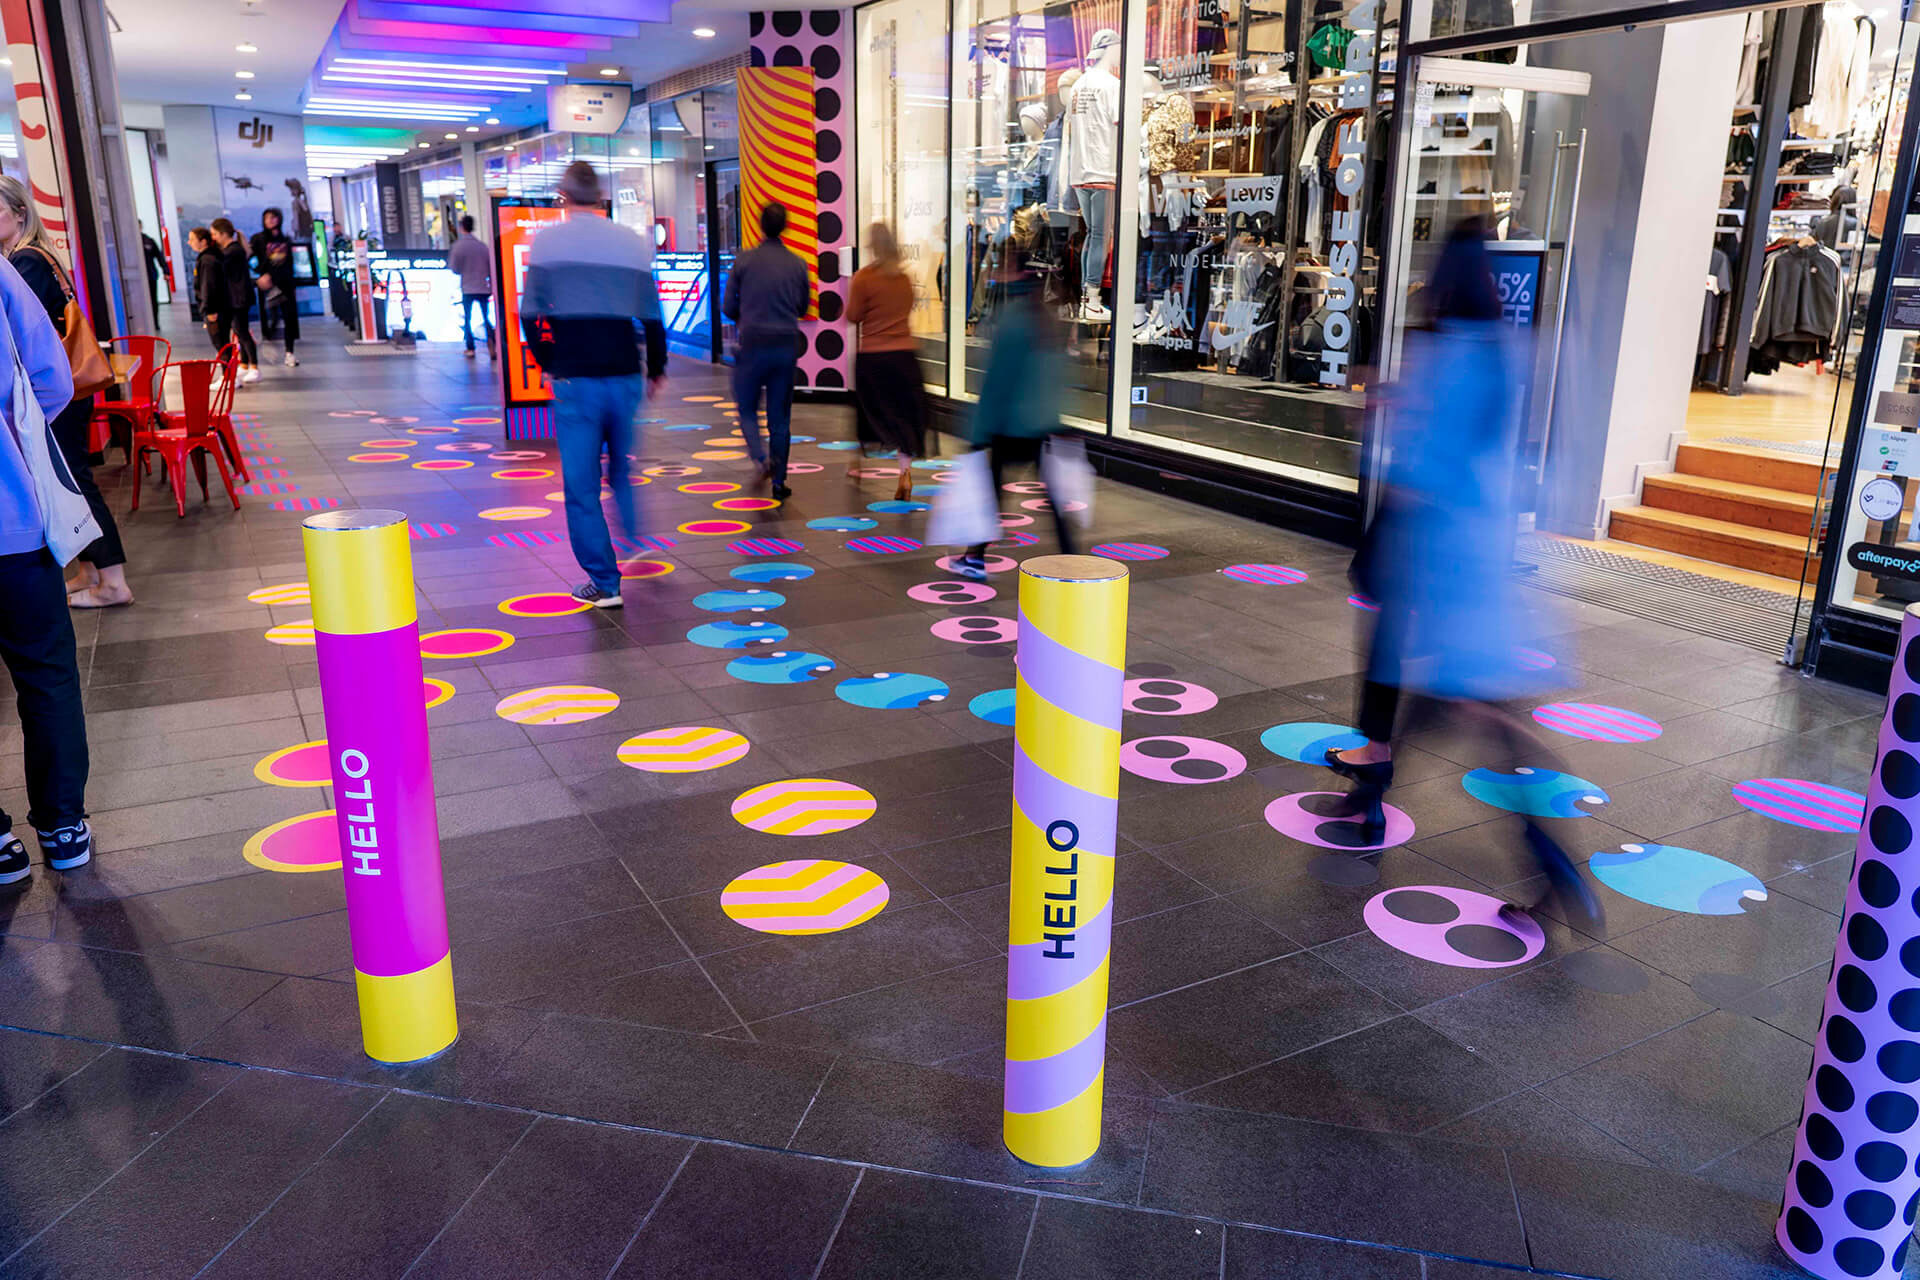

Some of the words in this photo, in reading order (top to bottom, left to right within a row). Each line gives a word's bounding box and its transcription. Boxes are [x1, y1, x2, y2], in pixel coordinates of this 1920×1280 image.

[1182, 0, 1229, 21] ARTICL
[1156, 50, 1213, 80] TOMMY
[1180, 73, 1212, 89] JEANS
[1336, 124, 1367, 197] OF
[1320, 210, 1360, 386] HOUSE
[1857, 550, 1909, 571] afterpay
[341, 749, 382, 876] HELLO
[1043, 820, 1080, 959] HELLO
